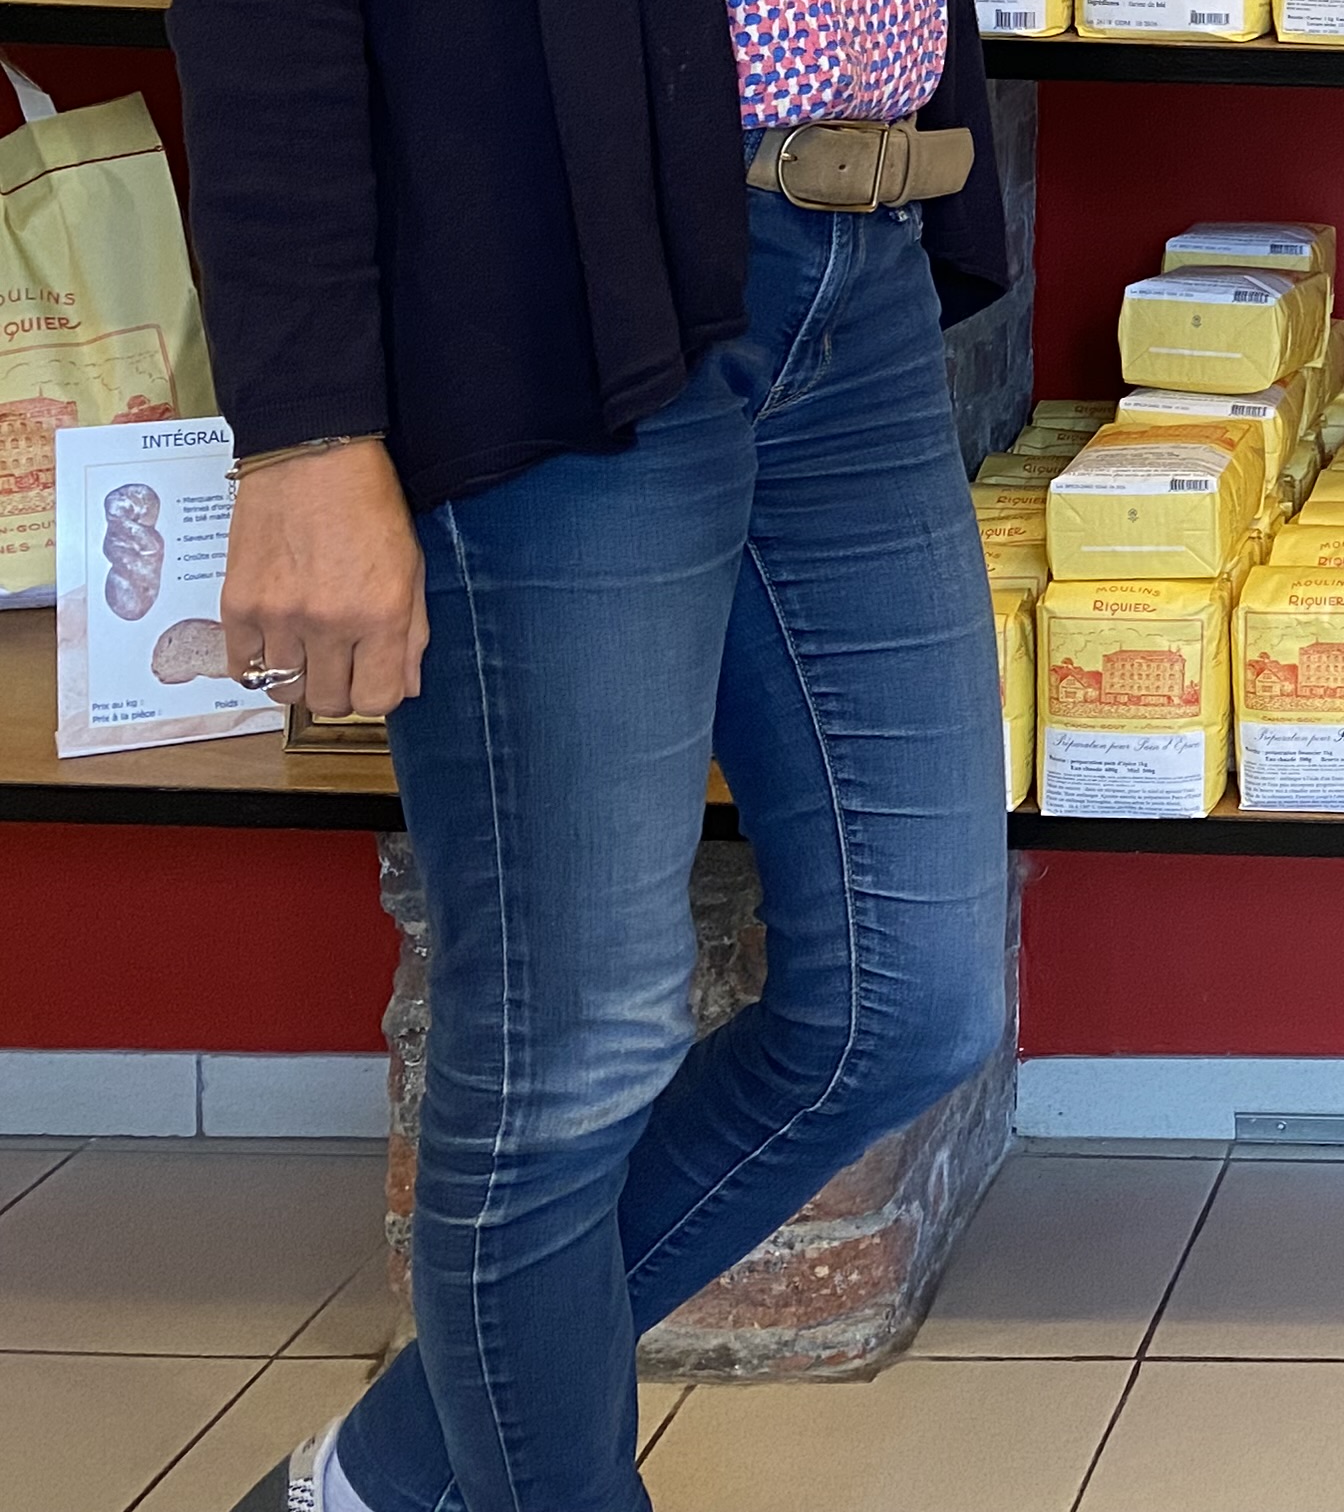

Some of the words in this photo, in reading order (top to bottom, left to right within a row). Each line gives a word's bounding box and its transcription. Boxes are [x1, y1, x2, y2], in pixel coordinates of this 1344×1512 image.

[142, 429, 230, 450] INTÉGRAL
[1096, 585, 1161, 598] MOULINS
[1093, 599, 1157, 617] RIQUIER
[92, 702, 109, 712] Prix
[111, 701, 124, 709] au
[126, 699, 138, 710] kg
[214, 699, 238, 710] Poids
[92, 714, 110, 724] Prix
[120, 712, 128, 720] la
